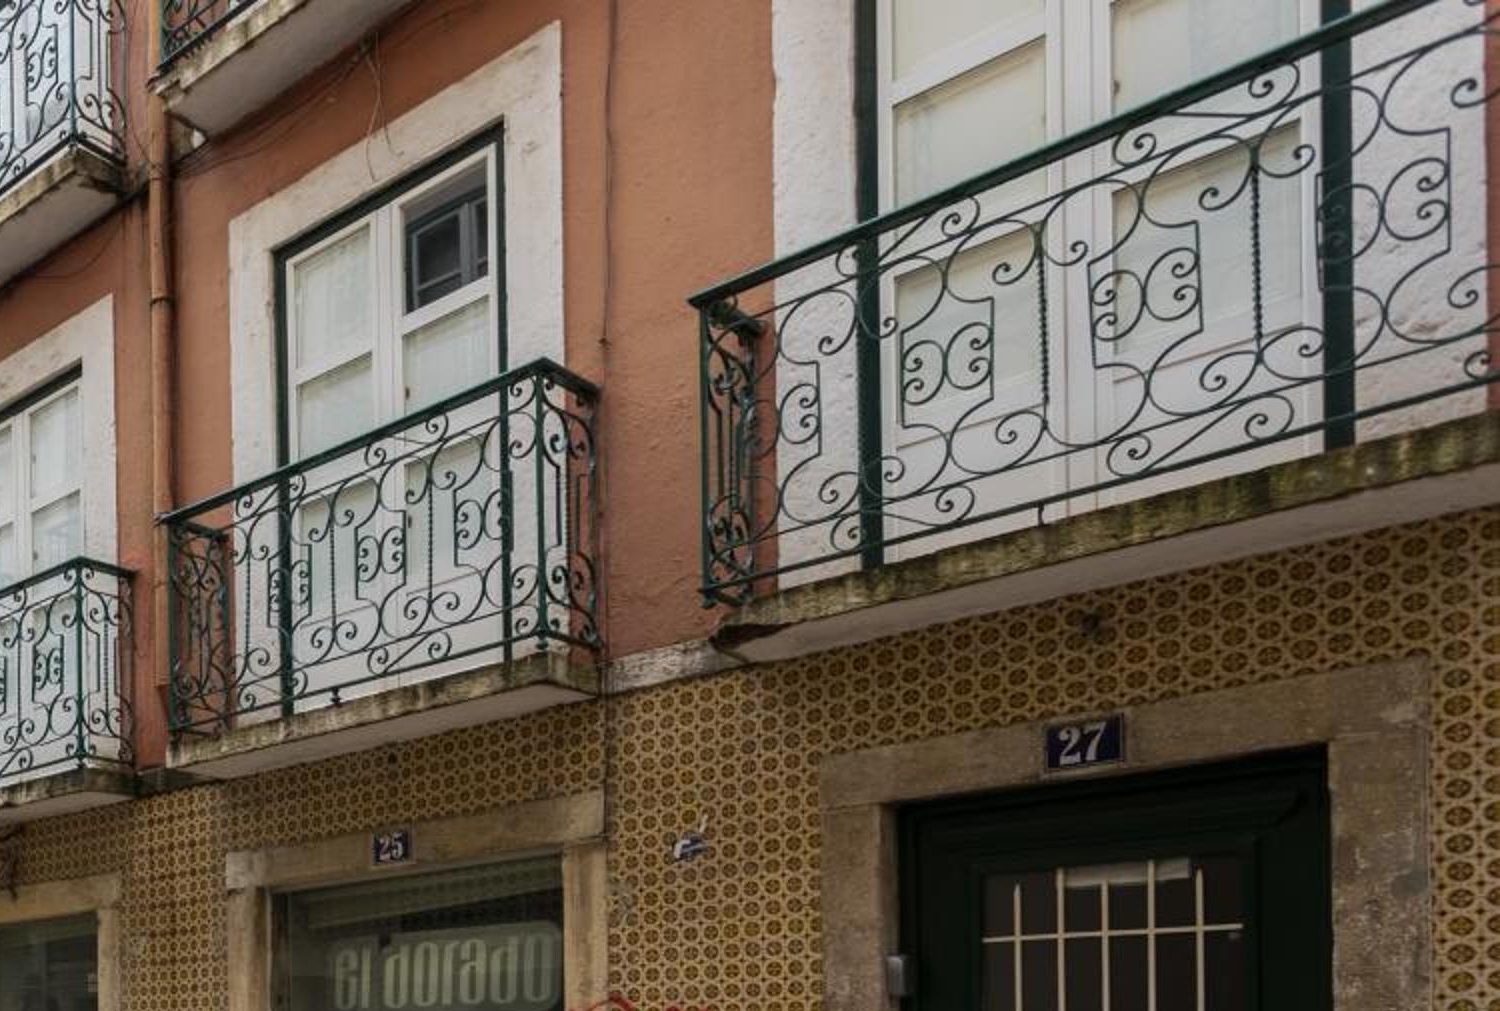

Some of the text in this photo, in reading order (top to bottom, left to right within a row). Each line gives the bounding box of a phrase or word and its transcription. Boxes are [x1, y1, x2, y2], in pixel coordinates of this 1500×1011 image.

[1059, 721, 1107, 765] 27
[379, 832, 404, 860] 25
[334, 932, 558, 1011] el dorado
